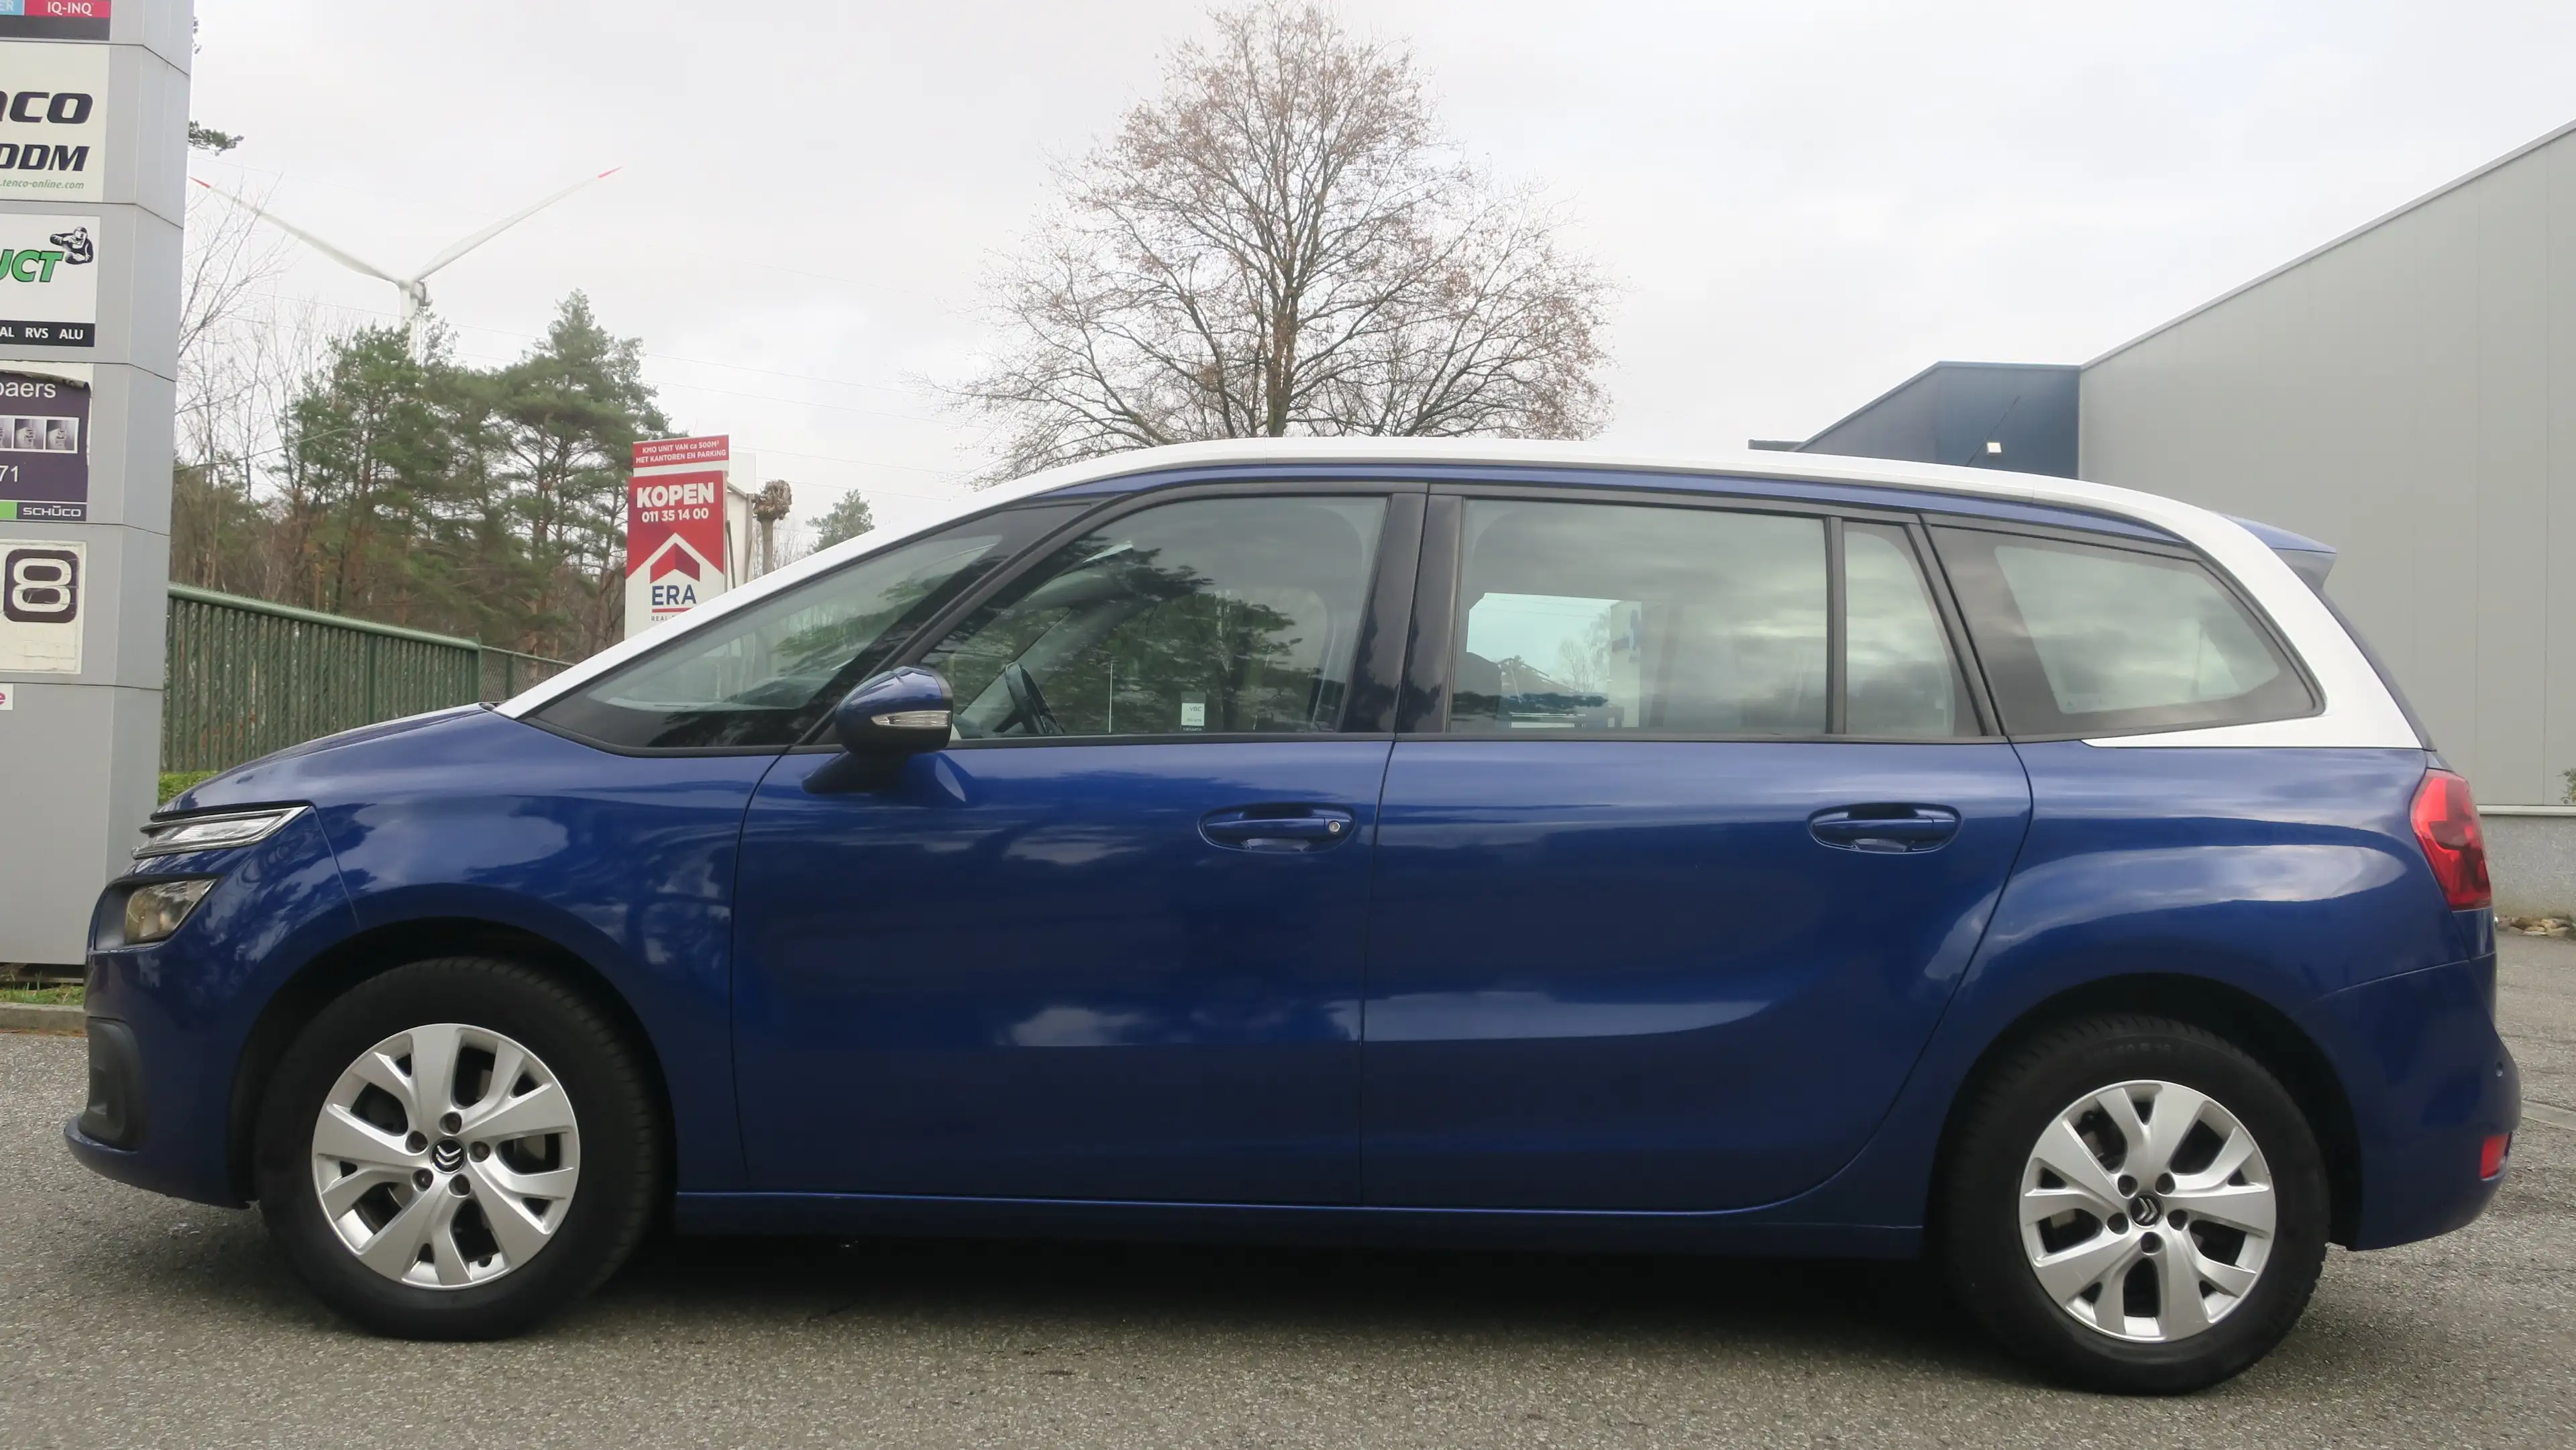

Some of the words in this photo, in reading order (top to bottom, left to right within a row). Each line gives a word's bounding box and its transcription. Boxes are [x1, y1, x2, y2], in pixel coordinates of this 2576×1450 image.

[47, 1, 93, 16] IQ-INQ
[0, 91, 93, 125] CO
[25, 327, 49, 339] RVS
[59, 328, 84, 340] ALU
[642, 446, 657, 454] KMO
[658, 444, 674, 453] UNIT
[675, 443, 688, 451] VAN
[650, 453, 686, 462] KANTOREN
[687, 452, 696, 460] EN
[697, 449, 727, 459] PARKING
[637, 482, 714, 509] KOPEN
[641, 511, 659, 523] 011
[661, 509, 675, 522] 35
[678, 509, 690, 521] 14
[693, 507, 709, 519] 00
[12, 558, 72, 613] 8
[651, 584, 697, 606] ERA
